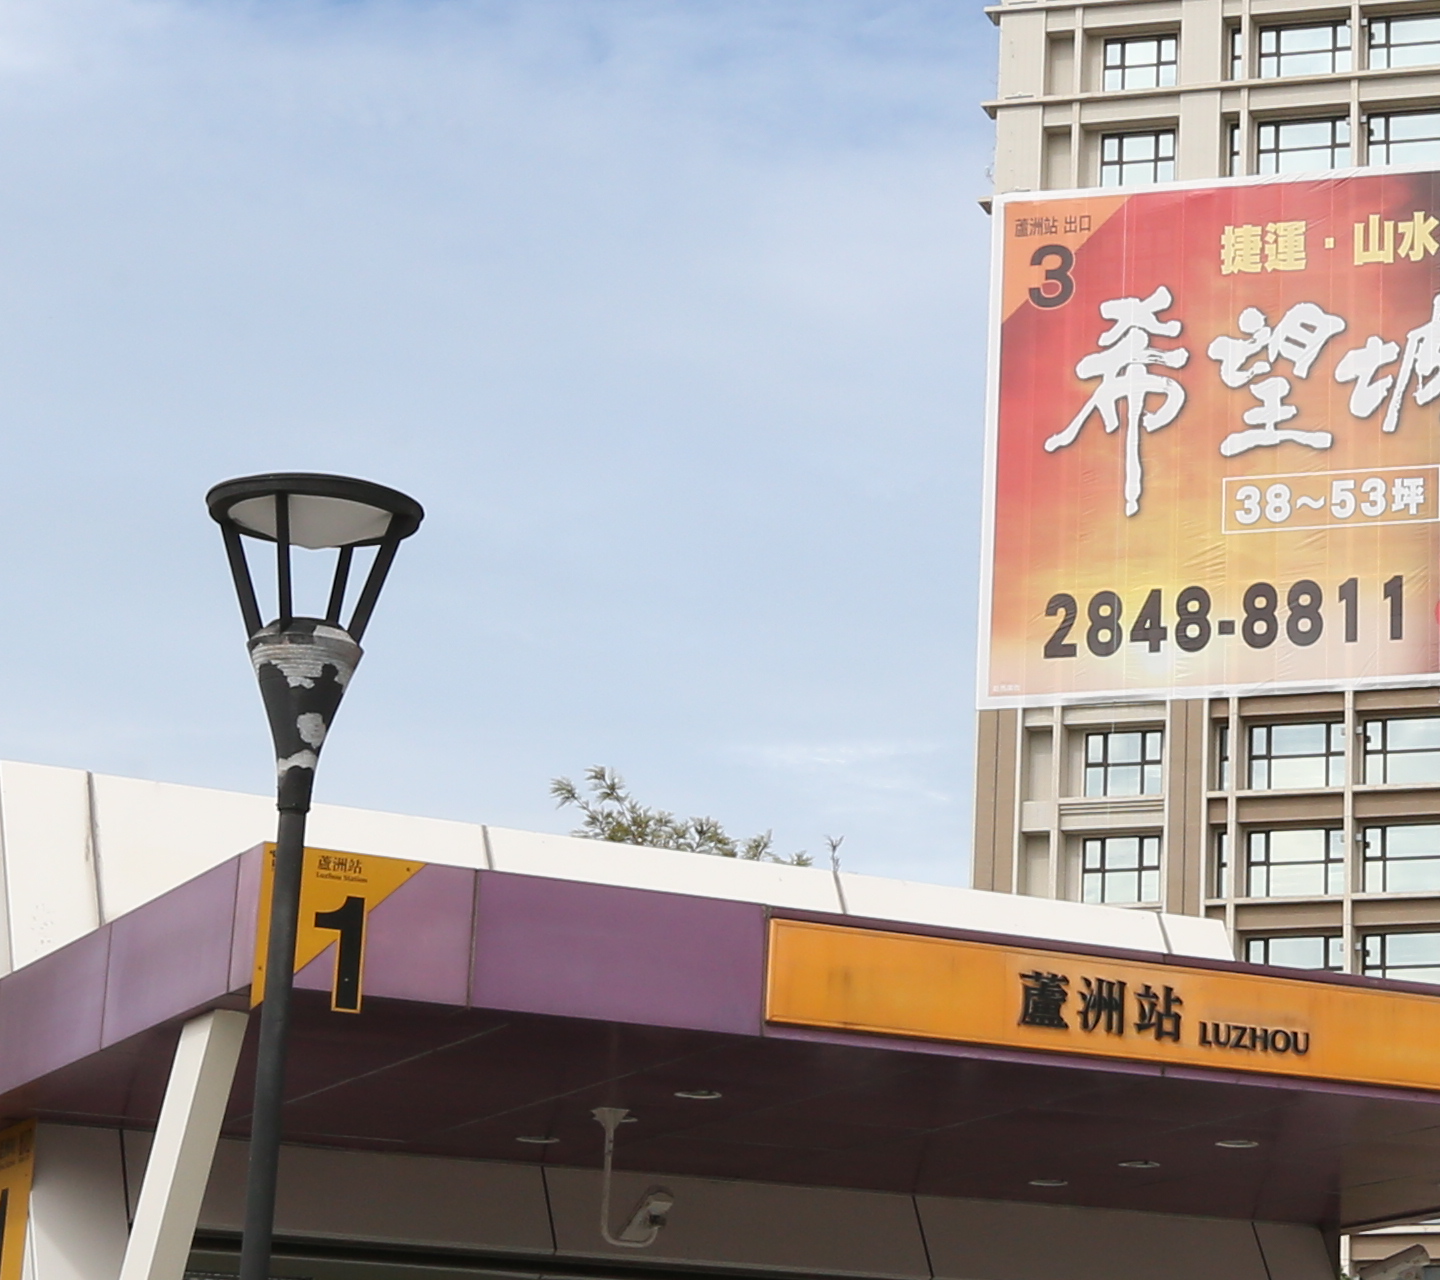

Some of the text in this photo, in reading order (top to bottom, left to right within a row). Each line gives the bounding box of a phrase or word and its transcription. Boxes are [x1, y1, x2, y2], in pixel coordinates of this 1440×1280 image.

[1015, 215, 1092, 237] 蘆洲站 出口
[1028, 243, 1075, 308] 3
[1043, 575, 1404, 660] 2848-8811
[317, 855, 362, 874] 蘆洲站
[314, 895, 366, 1010] 1
[1017, 969, 1310, 1056] 蘆洲站 LUZHOU
